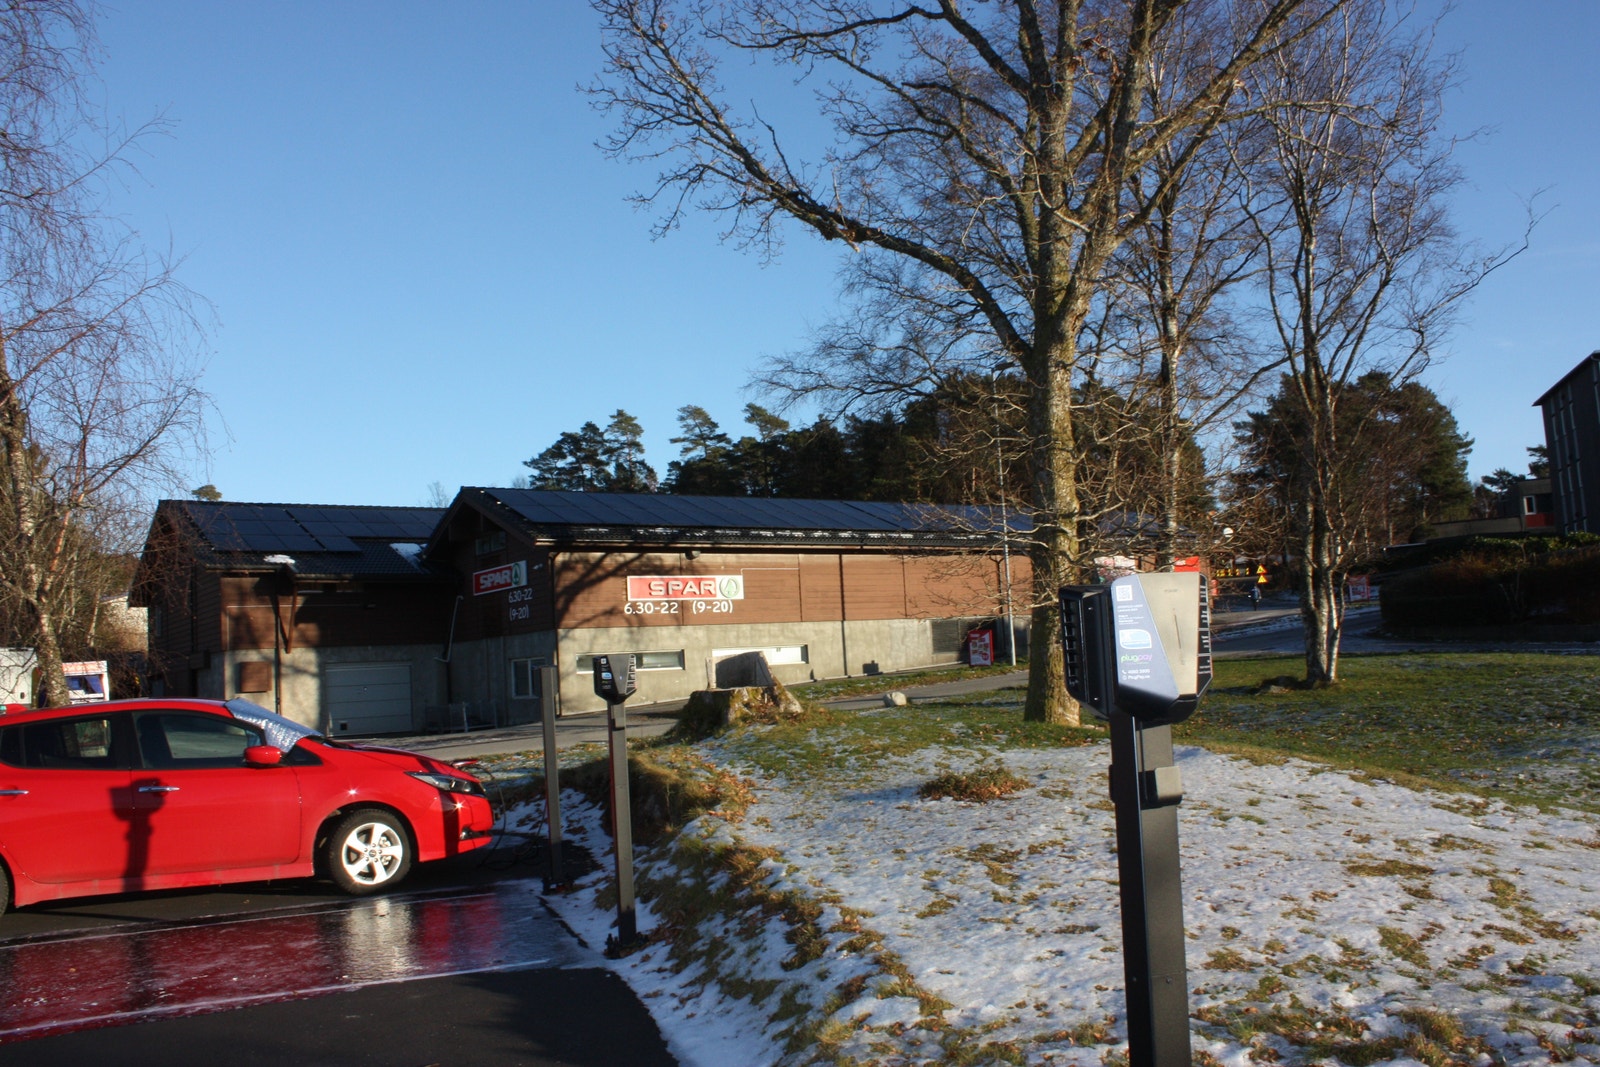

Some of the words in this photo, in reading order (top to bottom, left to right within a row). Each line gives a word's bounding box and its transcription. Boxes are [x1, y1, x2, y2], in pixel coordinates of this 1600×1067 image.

[480, 570, 510, 589] SPAR
[649, 580, 716, 596] SPAR
[624, 601, 679, 614] 6.30-22
[692, 600, 733, 614] (9-20)
